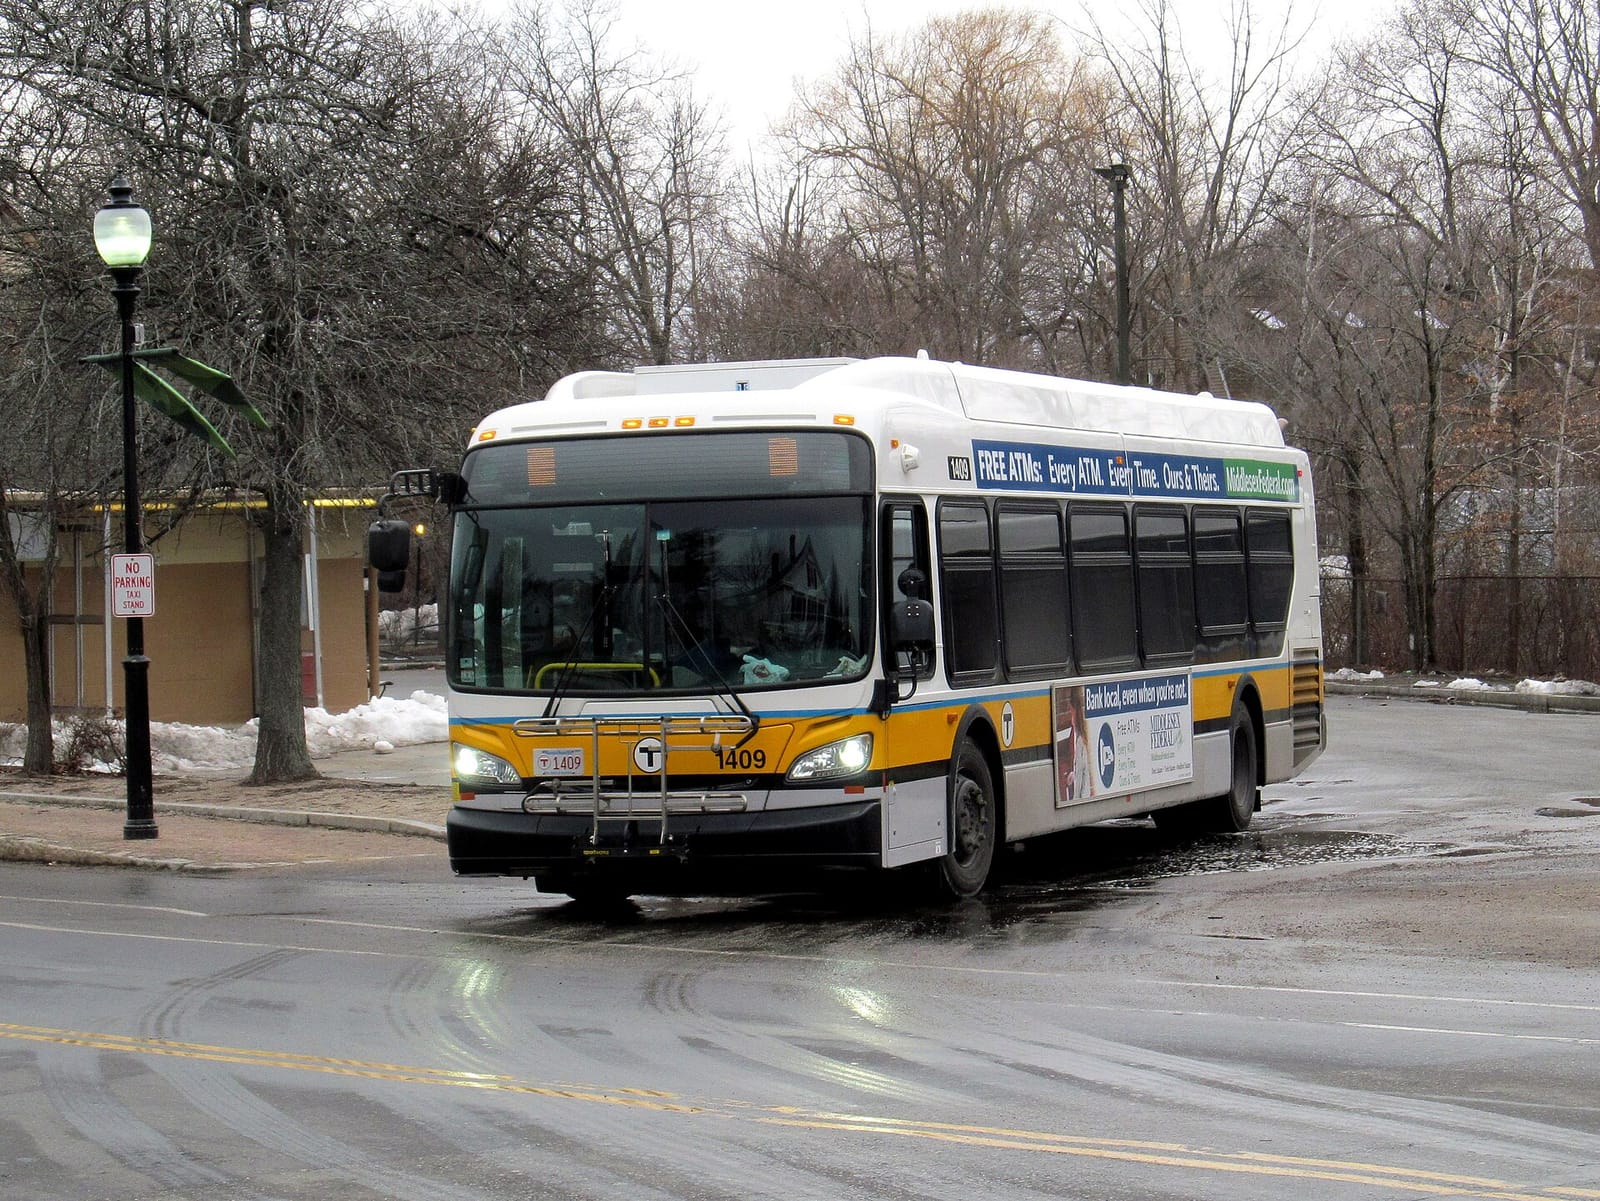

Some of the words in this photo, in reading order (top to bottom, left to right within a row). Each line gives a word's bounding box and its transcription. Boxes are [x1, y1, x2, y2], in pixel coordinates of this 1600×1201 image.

[951, 456, 969, 480] 1409
[978, 449, 1008, 481] FREE
[1009, 452, 1043, 483] ATMs:
[1048, 455, 1076, 491] Every
[1078, 457, 1105, 486] ATM.
[1107, 459, 1134, 494] Every
[1134, 461, 1160, 489] Time.
[1163, 462, 1184, 490] Ours
[1185, 464, 1192, 491] &
[1192, 464, 1220, 492] Theirs.
[1226, 466, 1296, 496] MiddlesexFederal.com
[125, 562, 140, 574] NO
[115, 576, 151, 588] PARKING
[123, 601, 145, 609] STAND
[1086, 686, 1103, 711] Bank
[1104, 684, 1121, 710] local,
[1122, 688, 1138, 706] even
[1138, 681, 1156, 703] when
[1156, 680, 1174, 707] you're
[1175, 679, 1187, 699] not.
[1150, 712, 1181, 732] MIDDLESEX
[1150, 730, 1175, 750] FEDERAL
[553, 756, 581, 770] 1409
[639, 747, 661, 767] T
[715, 746, 766, 769] 1409
